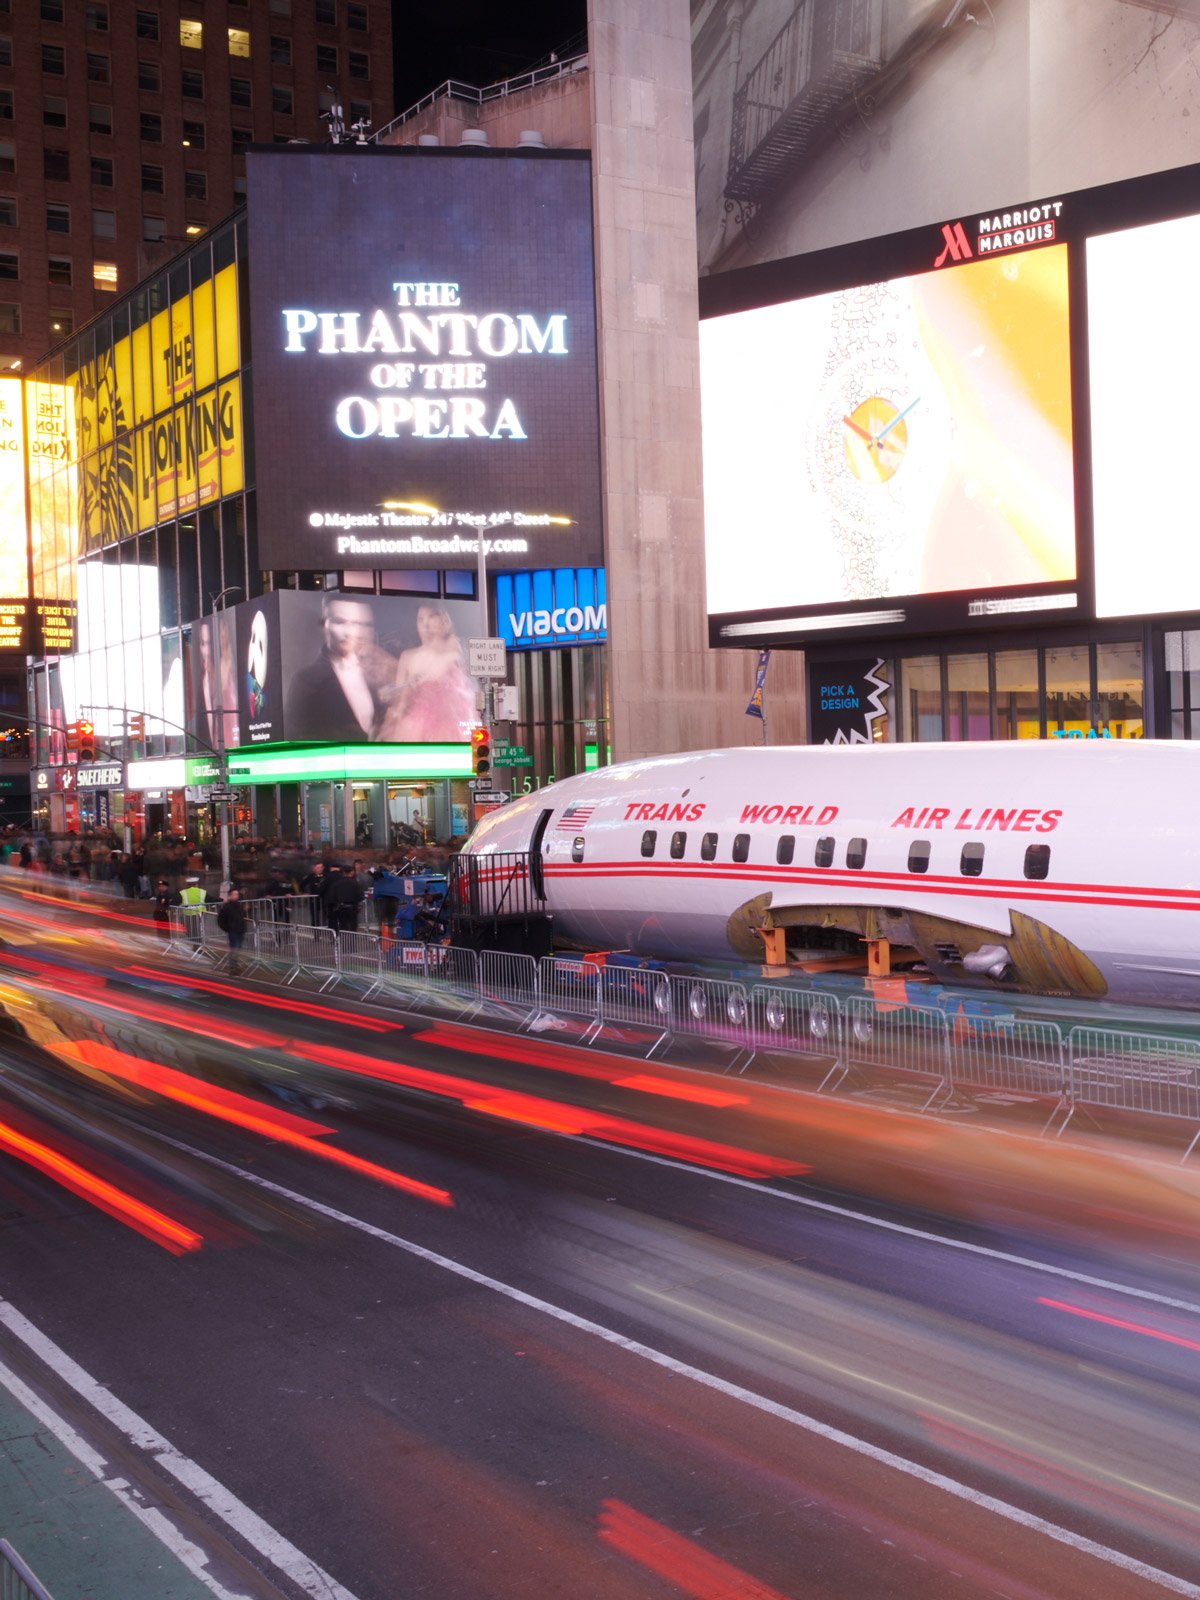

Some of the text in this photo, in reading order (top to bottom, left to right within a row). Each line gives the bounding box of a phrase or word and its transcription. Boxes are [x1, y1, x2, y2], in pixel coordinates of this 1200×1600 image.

[979, 202, 1063, 233] MARRIOTT
[980, 224, 1053, 252] MARQUIS
[393, 283, 461, 306] THE
[282, 310, 568, 355] PHANTOM
[163, 334, 193, 387] THE
[371, 364, 486, 388] OF THE
[336, 396, 528, 438] OPERA
[140, 391, 235, 501] LION KING
[325, 512, 379, 529] Majestic
[381, 511, 429, 526] Theatre
[513, 512, 550, 526] Street
[477, 654, 497, 662] MUST
[820, 684, 855, 697] PICK A
[820, 697, 860, 711] DESIGN
[77, 768, 122, 786] SKECHERS
[622, 803, 1063, 832] TRANS WORLD AIR LINES
